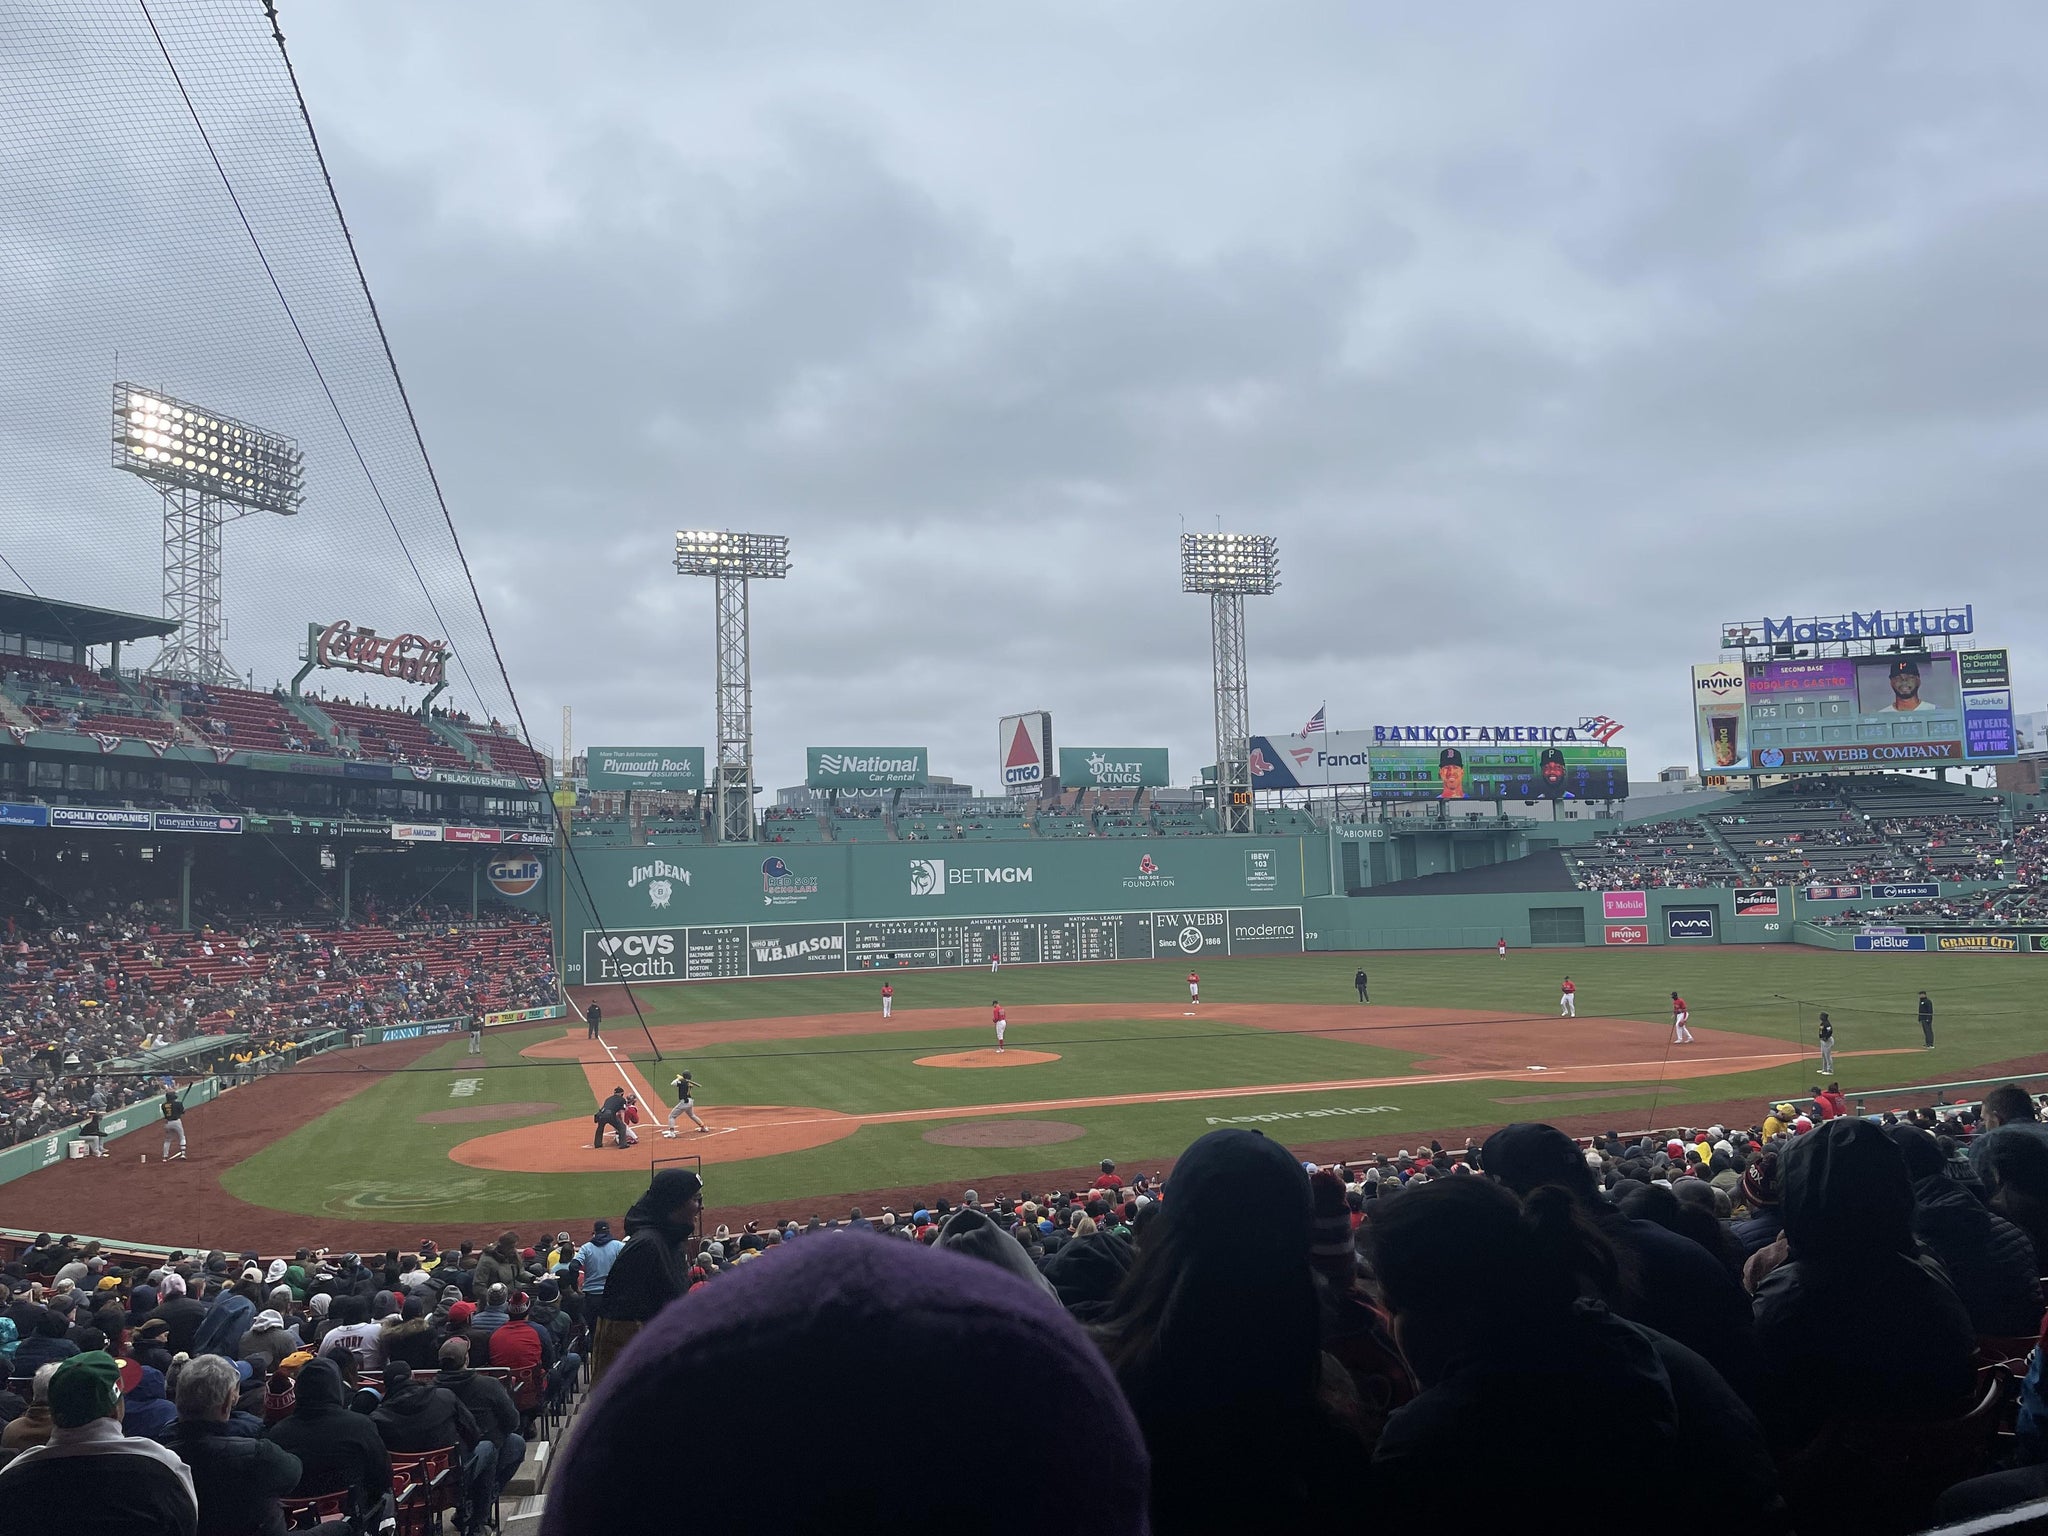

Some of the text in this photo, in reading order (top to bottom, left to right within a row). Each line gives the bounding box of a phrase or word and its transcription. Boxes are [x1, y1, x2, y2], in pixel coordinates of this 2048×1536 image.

[1763, 604, 1974, 644] MassMutual
[318, 620, 448, 684] Coca-Cola
[1962, 653, 2002, 661] Dedicated
[1781, 666, 1805, 674] SECOND
[1697, 677, 1743, 689] IRVING
[1970, 698, 2003, 706] StubHub
[1755, 705, 1838, 718] .125 0 0
[1968, 719, 1982, 729] ANY
[1374, 726, 1578, 741] BANK OF AMERICA
[1970, 730, 1985, 740] ANY
[1973, 742, 1988, 752] ANY
[1792, 745, 1952, 763] F.W. WEBB COMPANY
[603, 758, 691, 773] Plymouth Rock
[1089, 762, 1142, 775] DRAFT
[886, 773, 915, 781] Rental
[1005, 765, 1040, 783] CITGO
[1096, 773, 1141, 784] KINGS
[447, 774, 516, 788] BLACK LIVES MATTER
[1500, 784, 1507, 795] 2
[1521, 784, 1528, 795] 0
[54, 810, 149, 823] COGHLIN COMPANIES
[158, 818, 218, 829] vineyard vines
[1343, 829, 1384, 838] ABIOMED
[488, 863, 539, 880] Gulf
[628, 860, 692, 888] JIM BEAM
[950, 867, 1033, 884] BETMGM
[769, 876, 818, 886] RED SOX
[1123, 880, 1175, 888] FOUNDATION
[1615, 901, 1643, 909] Mobile
[1736, 895, 1777, 904] Safelite
[868, 921, 907, 929] FENWAY
[1157, 913, 1223, 927] F.W. WEBB
[1671, 920, 1709, 928] nuna
[1235, 924, 1295, 937] moderna
[1764, 923, 1780, 931] 420
[1305, 932, 1318, 940] 379
[1611, 930, 1641, 938] IRVING
[623, 934, 675, 956] CVS
[751, 939, 780, 948] WHO BUT
[1159, 939, 1177, 947] Since
[1870, 936, 1908, 950] jetBlue
[1940, 936, 2016, 949] GRANITE CITY
[567, 964, 581, 972] 310
[600, 957, 675, 978] Health
[382, 1026, 422, 1042] ZENNI
[1205, 1104, 1402, 1126] Aspiration
[334, 1334, 364, 1348] STORY
